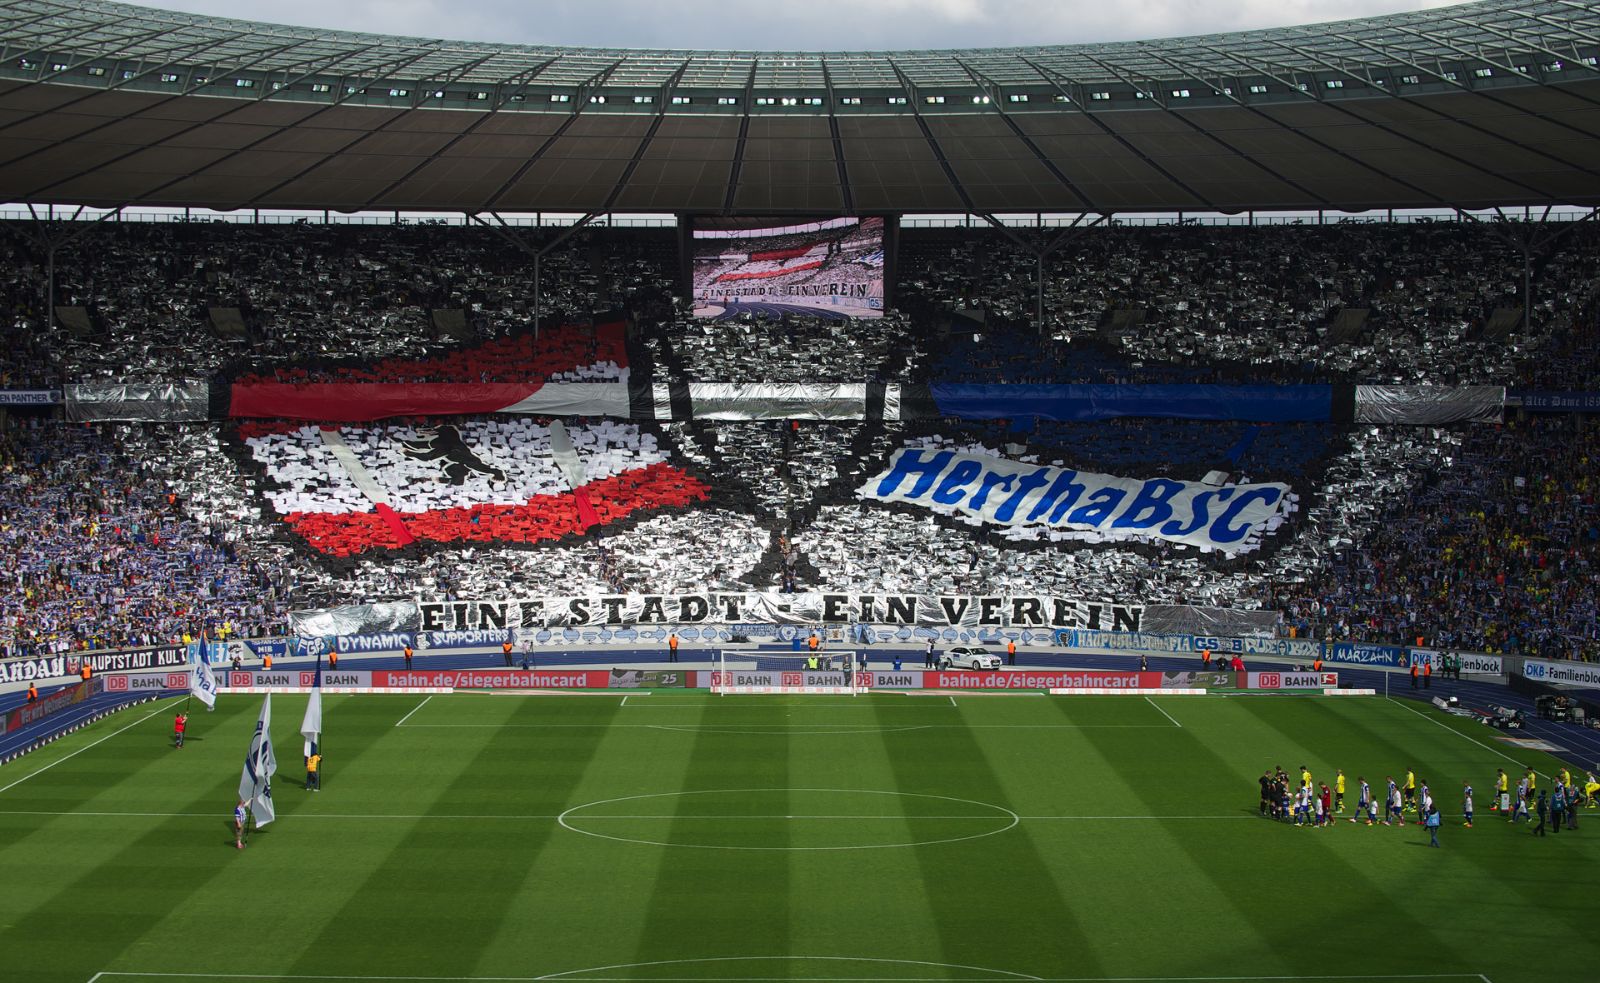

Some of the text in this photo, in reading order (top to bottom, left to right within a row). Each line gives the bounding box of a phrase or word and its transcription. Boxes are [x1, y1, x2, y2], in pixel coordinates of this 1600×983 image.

[735, 287, 773, 296] STADT
[788, 285, 811, 296] EIN
[814, 283, 867, 297] VEREIN
[11, 394, 48, 402] PANTHER
[1525, 396, 1547, 406] Alte
[1552, 396, 1580, 406] Dame
[420, 601, 544, 630] EINE
[569, 596, 746, 625] STADT
[822, 595, 917, 623] EIN
[941, 597, 1142, 632] VEREIN
[338, 629, 510, 650] DYNAMIC SUPPORTERS
[1195, 638, 1219, 650] GS
[1245, 638, 1278, 654] RUDE
[84, 648, 186, 671] HAUPTSTADT KULT
[1336, 648, 1393, 663] MARZAHN
[109, 677, 163, 690] DB BAHN
[169, 675, 186, 687] DB
[233, 673, 251, 685] DB
[256, 676, 290, 685] BAHN
[325, 675, 359, 685] BAHN
[387, 673, 587, 688] bahn.de/siegerbahncard
[661, 674, 677, 684] 25
[712, 673, 772, 686] DB BAHN
[783, 673, 842, 686] DB BAHN
[854, 673, 912, 686] DB BAHN
[939, 673, 1139, 688] bahn.de/siegerbahncard
[1213, 675, 1228, 685] 25
[1260, 674, 1318, 687] DB BAHN
[1508, 721, 1520, 729] sky
